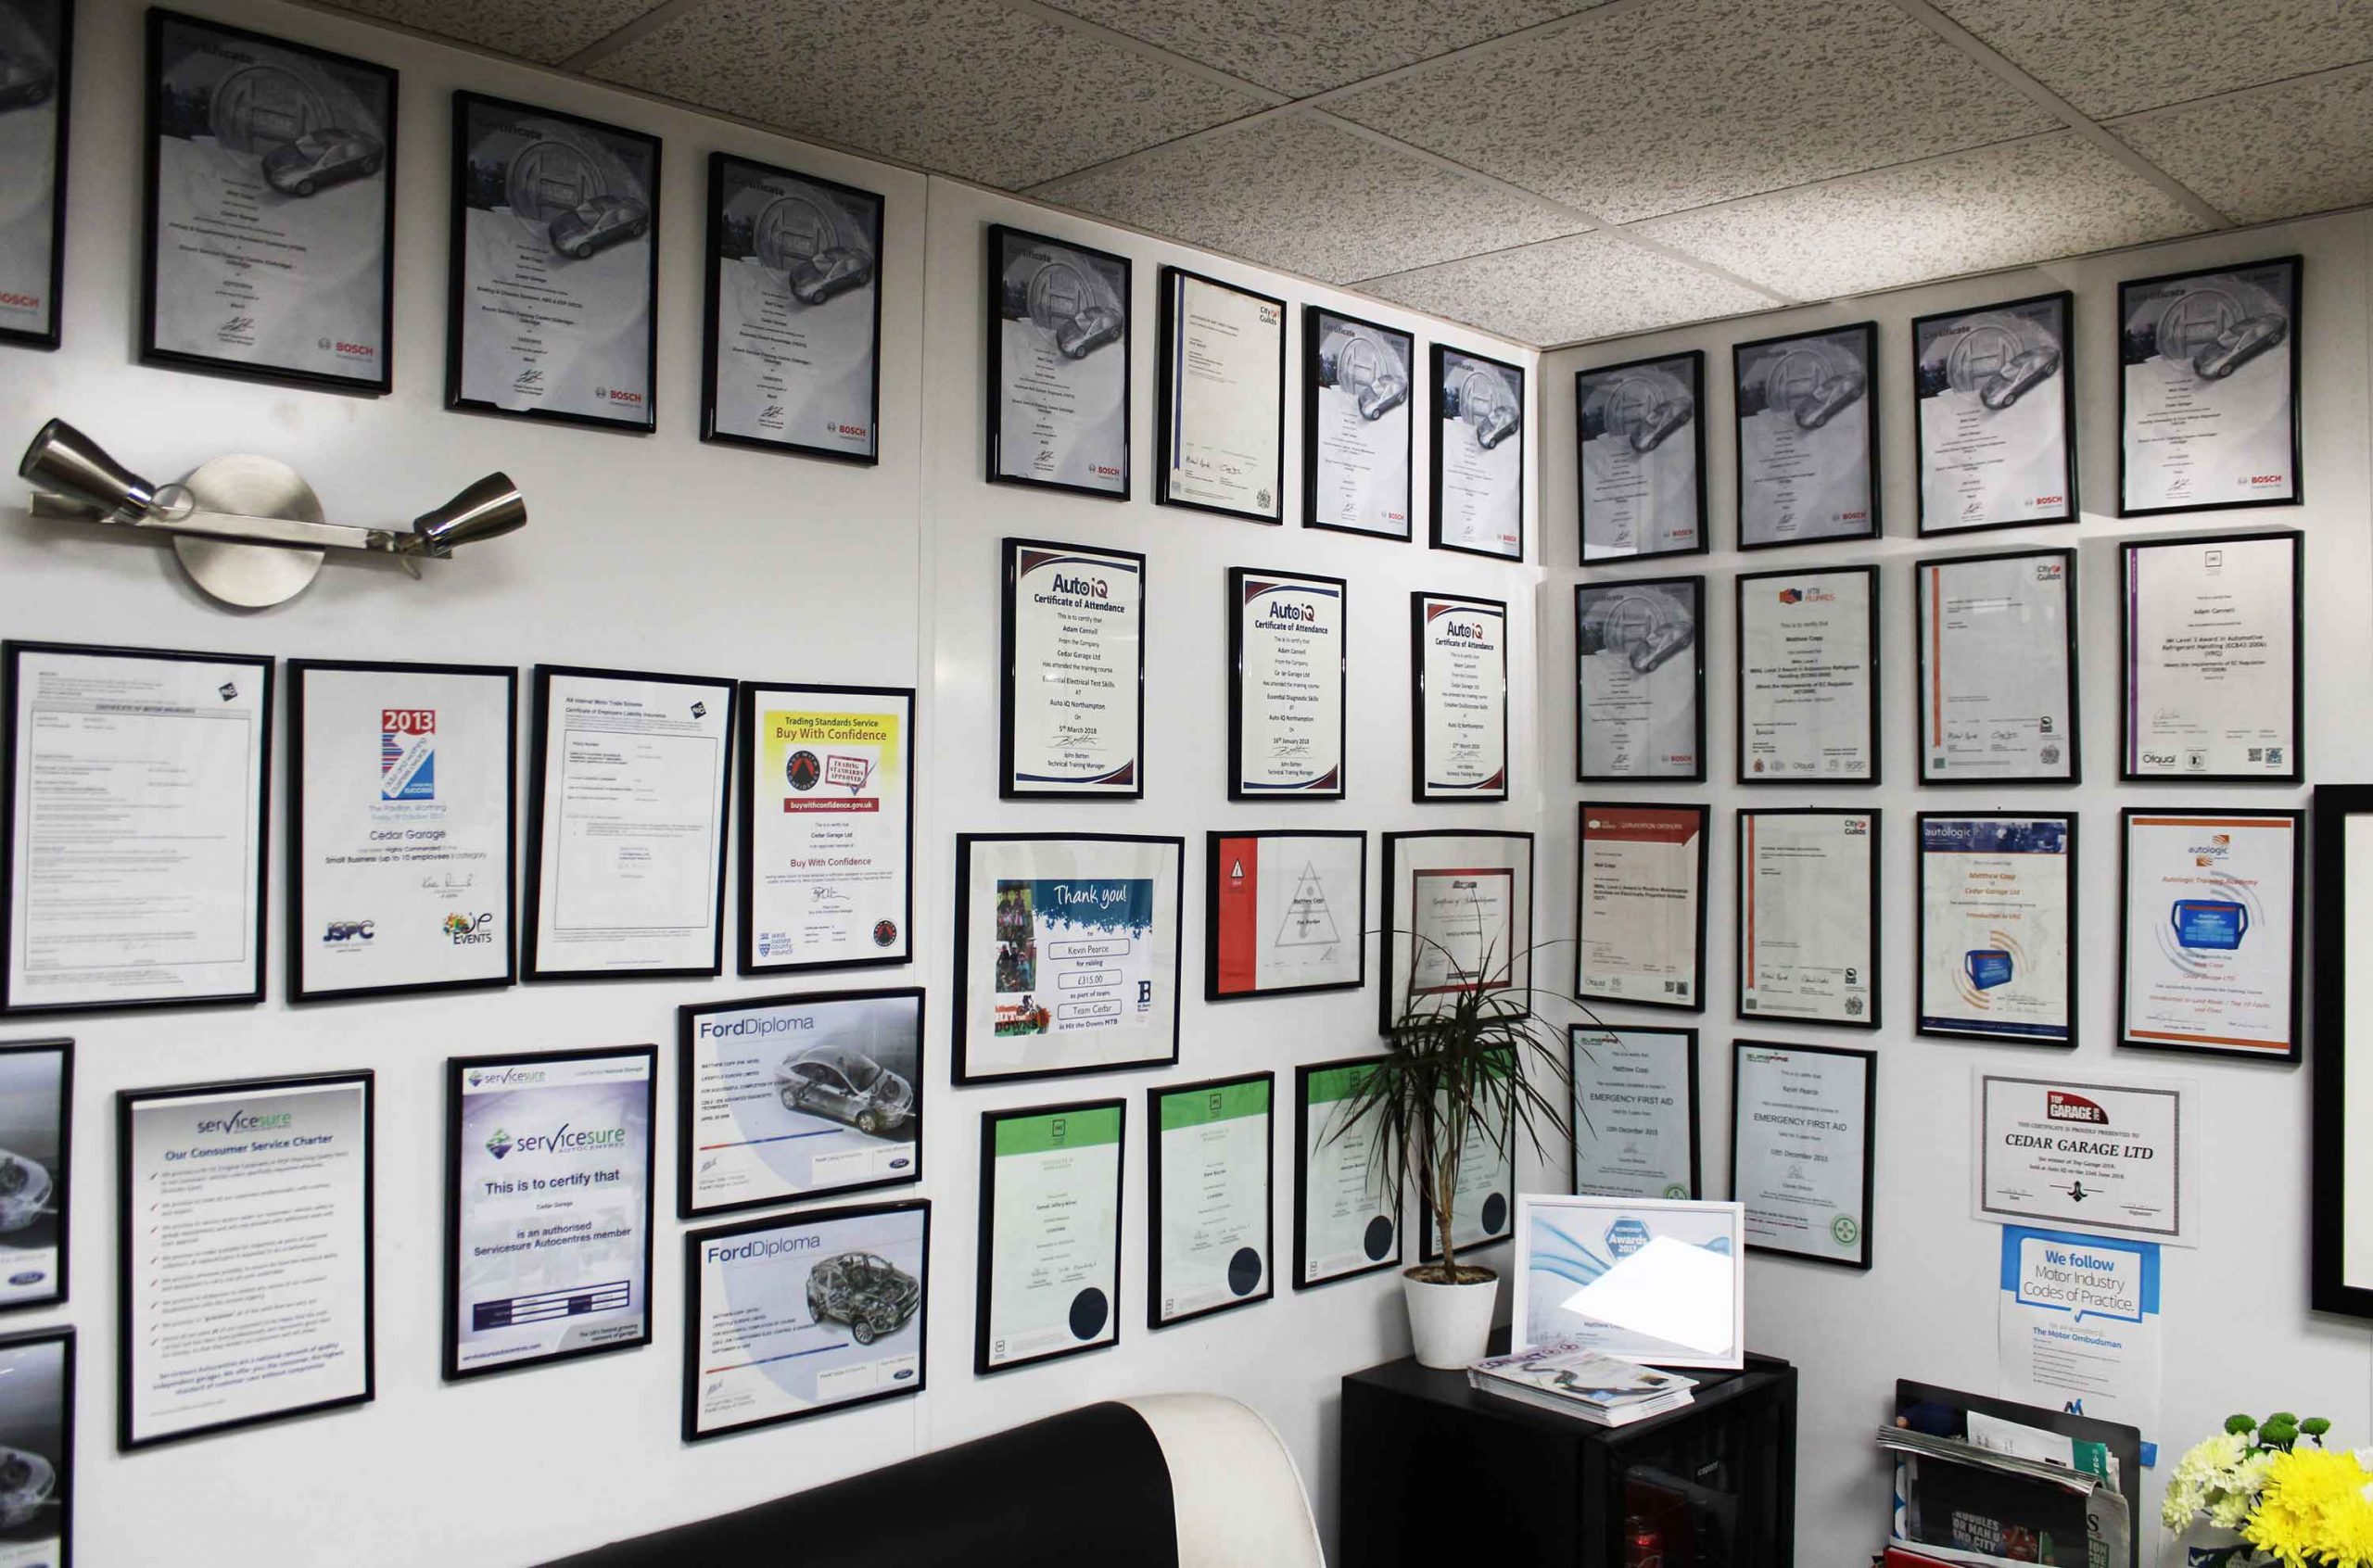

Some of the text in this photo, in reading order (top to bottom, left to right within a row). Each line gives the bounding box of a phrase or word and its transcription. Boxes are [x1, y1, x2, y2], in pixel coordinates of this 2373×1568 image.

[336, 342, 374, 356] BOSCH
[610, 389, 642, 402] BOSCH
[839, 425, 866, 436] BOSCH
[1098, 466, 1120, 476] BOSCH
[2252, 474, 2282, 484] BOSCH
[2037, 495, 2062, 505] BOSCH
[1389, 512, 1404, 521] BOSCH
[1843, 512, 1867, 520] BOSCH
[1034, 594, 1124, 613] Certificate of Attendance
[1255, 620, 1327, 635] Certificate of Attendance
[1436, 639, 1460, 647] Certificate
[1468, 641, 1493, 650] Attendance
[1067, 677, 1089, 686] Electrical
[1072, 701, 1105, 710] Northampton
[385, 712, 433, 730] 2013
[786, 717, 813, 727] Trading
[816, 718, 851, 727] Standards
[777, 727, 886, 740] Buy With Confidence
[370, 830, 446, 841] Cedar Garage
[1925, 828, 1971, 839] autologic
[2189, 846, 2227, 855] autologic
[791, 859, 805, 868] Buy
[1054, 885, 1126, 909] Thank you!
[1077, 975, 1102, 985] £315.00
[1073, 1005, 1112, 1015] Team Cedar
[1590, 1094, 1635, 1102] EMERGENCY
[2050, 1095, 2063, 1104] TOP
[2050, 1105, 2091, 1120] GARAGE
[1754, 1113, 1846, 1132] EMERGENCY FIRST AID
[165, 1134, 333, 1160] Our Consumer Service Charter
[2006, 1134, 2153, 1159] CEDAR GARAGE LTD
[486, 1170, 619, 1195] This is to certify that
[542, 1222, 591, 1235] authorised
[475, 1228, 631, 1257] Servicesure Autocentres member
[2045, 1250, 2114, 1271] We follow
[2036, 1265, 2125, 1294] Motor Industry
[2024, 1282, 2134, 1310] Codes of Practice.
[2049, 1330, 2070, 1339] Motor
[2072, 1334, 2121, 1347] Ombudsman
